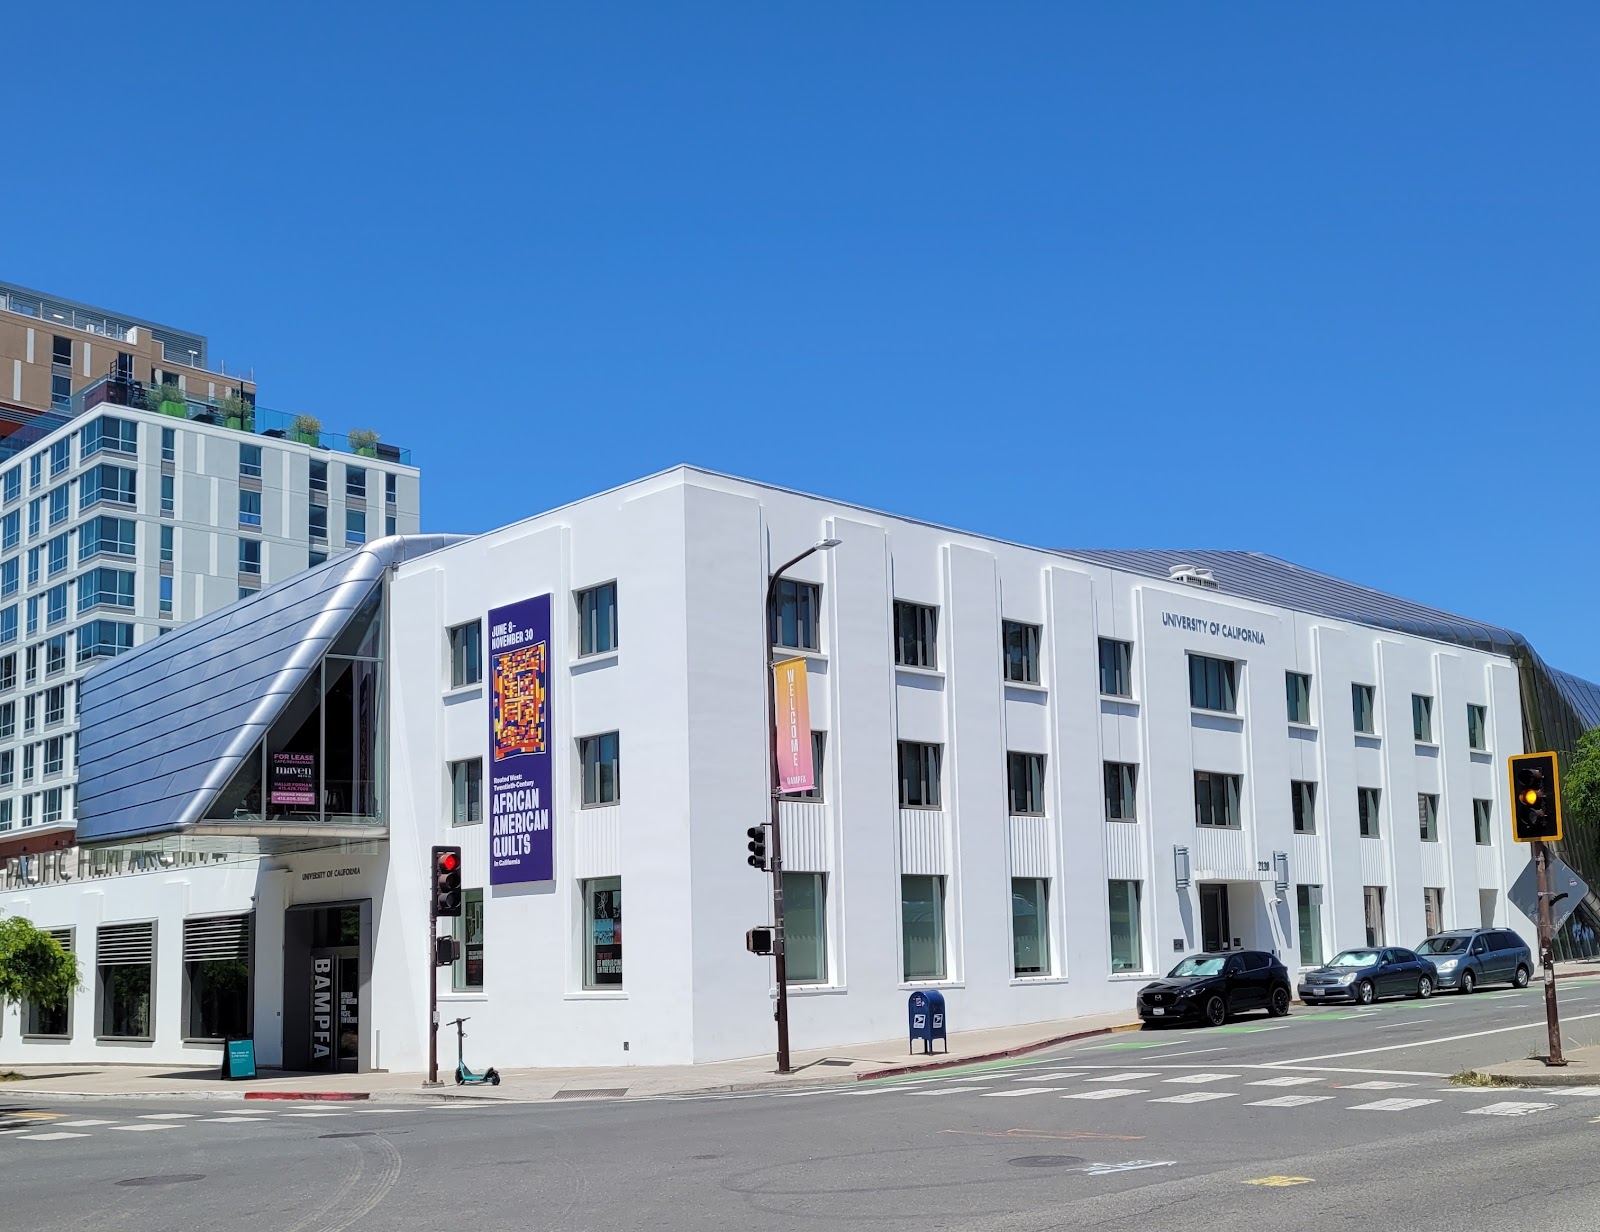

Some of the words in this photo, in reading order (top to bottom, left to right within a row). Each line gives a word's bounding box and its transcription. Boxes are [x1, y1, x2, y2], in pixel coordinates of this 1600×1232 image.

[491, 622, 507, 638] JUNE
[491, 631, 524, 650] NOVEMBER
[524, 627, 534, 642] 30
[1162, 612, 1208, 634] UNIVERSITY
[1210, 621, 1220, 636] OF
[1222, 625, 1266, 645] CALIFORNIA
[787, 668, 799, 767] WELCOME
[275, 766, 312, 775] maven
[492, 788, 540, 815] AFRICAN
[492, 809, 549, 836] AMERICAN
[493, 834, 531, 857] QUILTS
[6, 848, 73, 888] PACIFIC
[302, 870, 326, 881] UNIVERSITY
[326, 869, 333, 878] OF
[334, 867, 361, 877] CALIFORNIA
[313, 958, 331, 1059] BAMPFA
